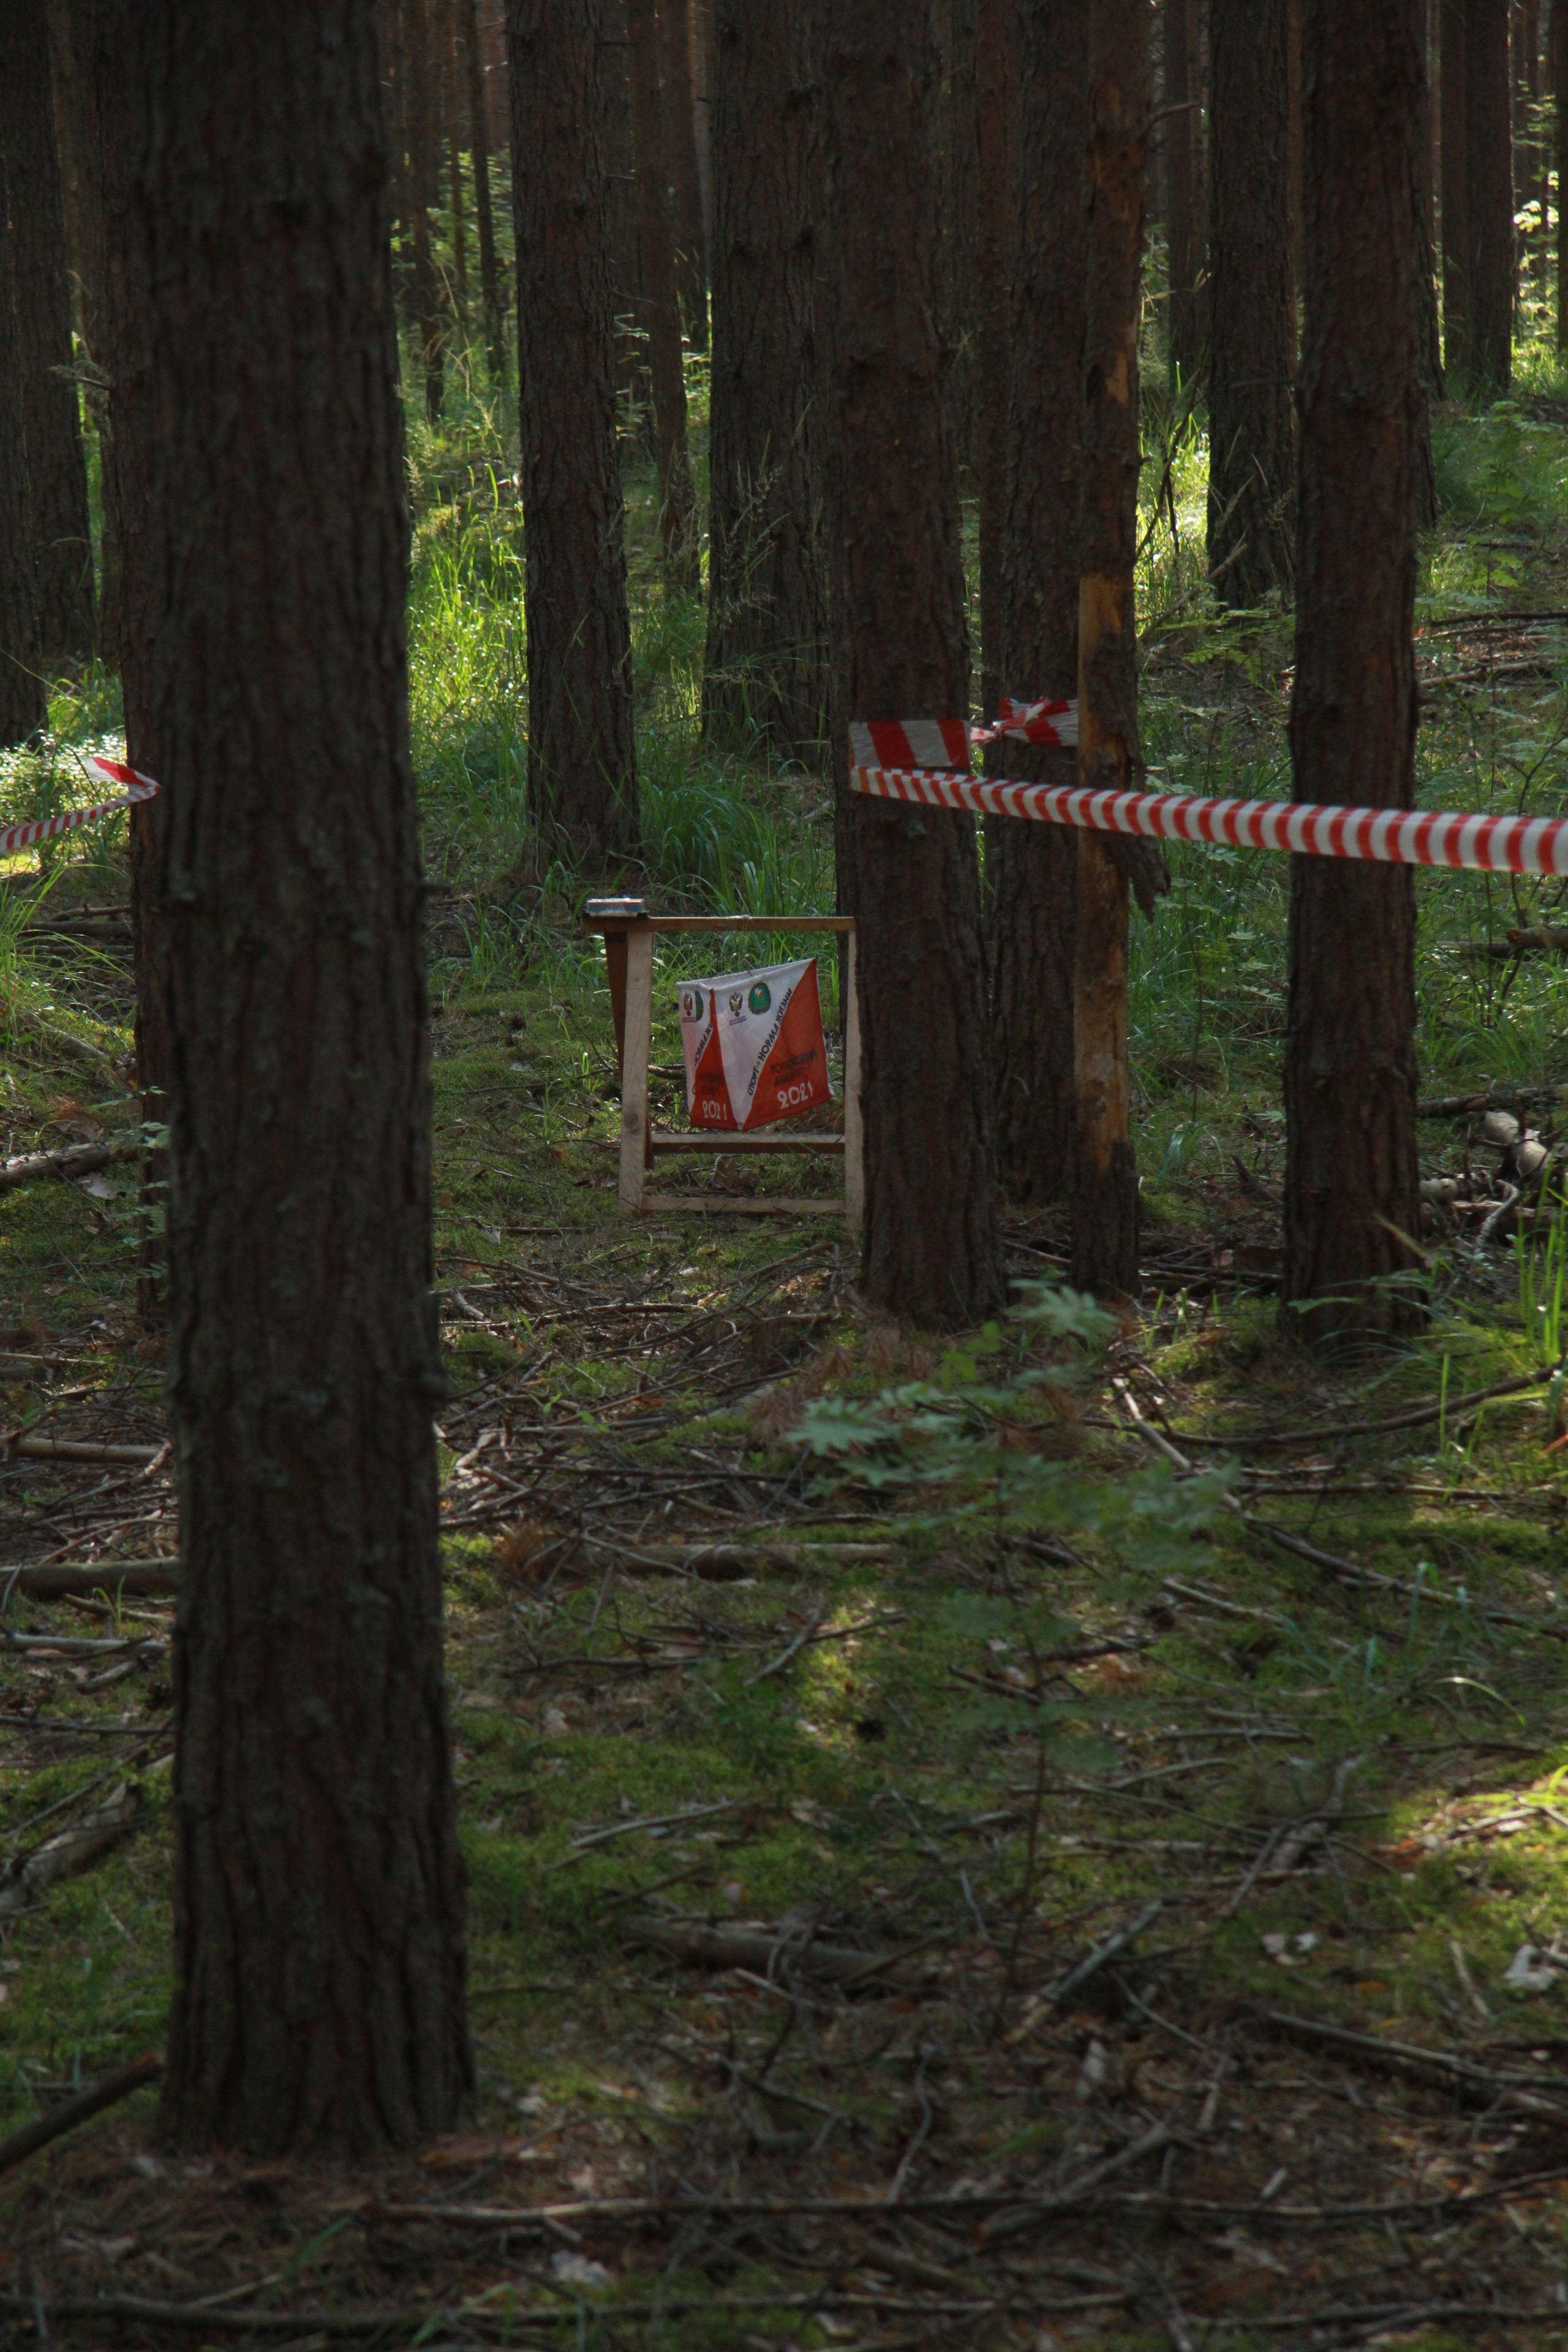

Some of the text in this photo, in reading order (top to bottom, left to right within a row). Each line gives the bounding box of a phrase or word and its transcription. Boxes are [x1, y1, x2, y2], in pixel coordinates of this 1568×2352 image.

[748, 988, 793, 1096] СПОРТ НОРМА ЖИЗНИ
[702, 1100, 727, 1120] 2021
[777, 1080, 813, 1110] 2021
